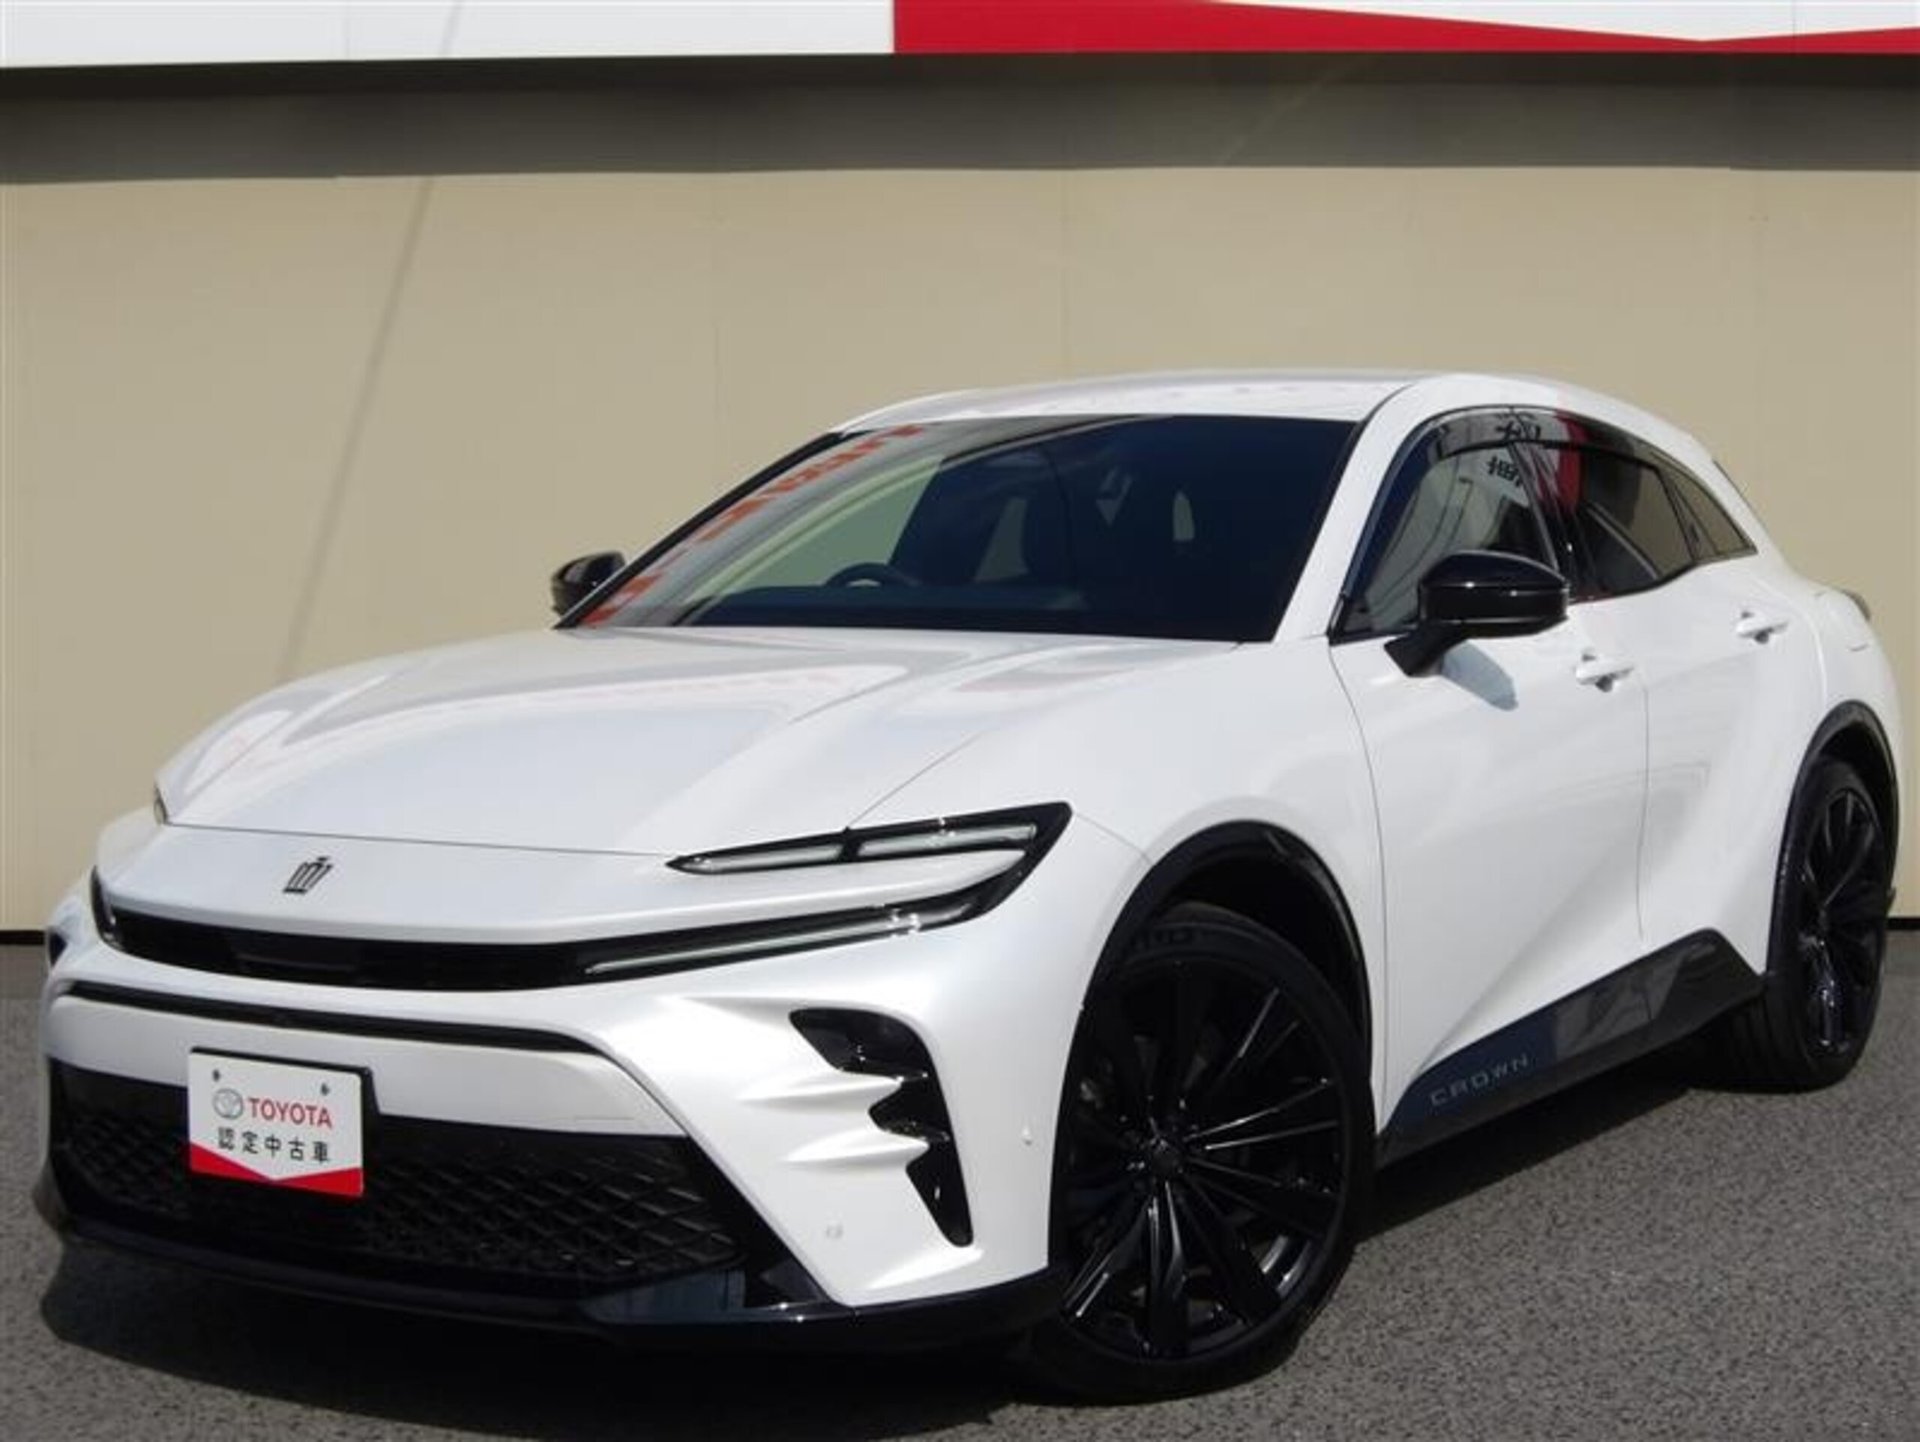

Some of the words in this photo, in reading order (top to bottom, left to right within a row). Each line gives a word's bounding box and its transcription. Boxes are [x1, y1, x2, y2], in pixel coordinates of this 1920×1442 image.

[1430, 1052, 1529, 1106] CROWN
[248, 1097, 333, 1129] TOYOTA
[218, 1126, 330, 1163] 認定中古車
